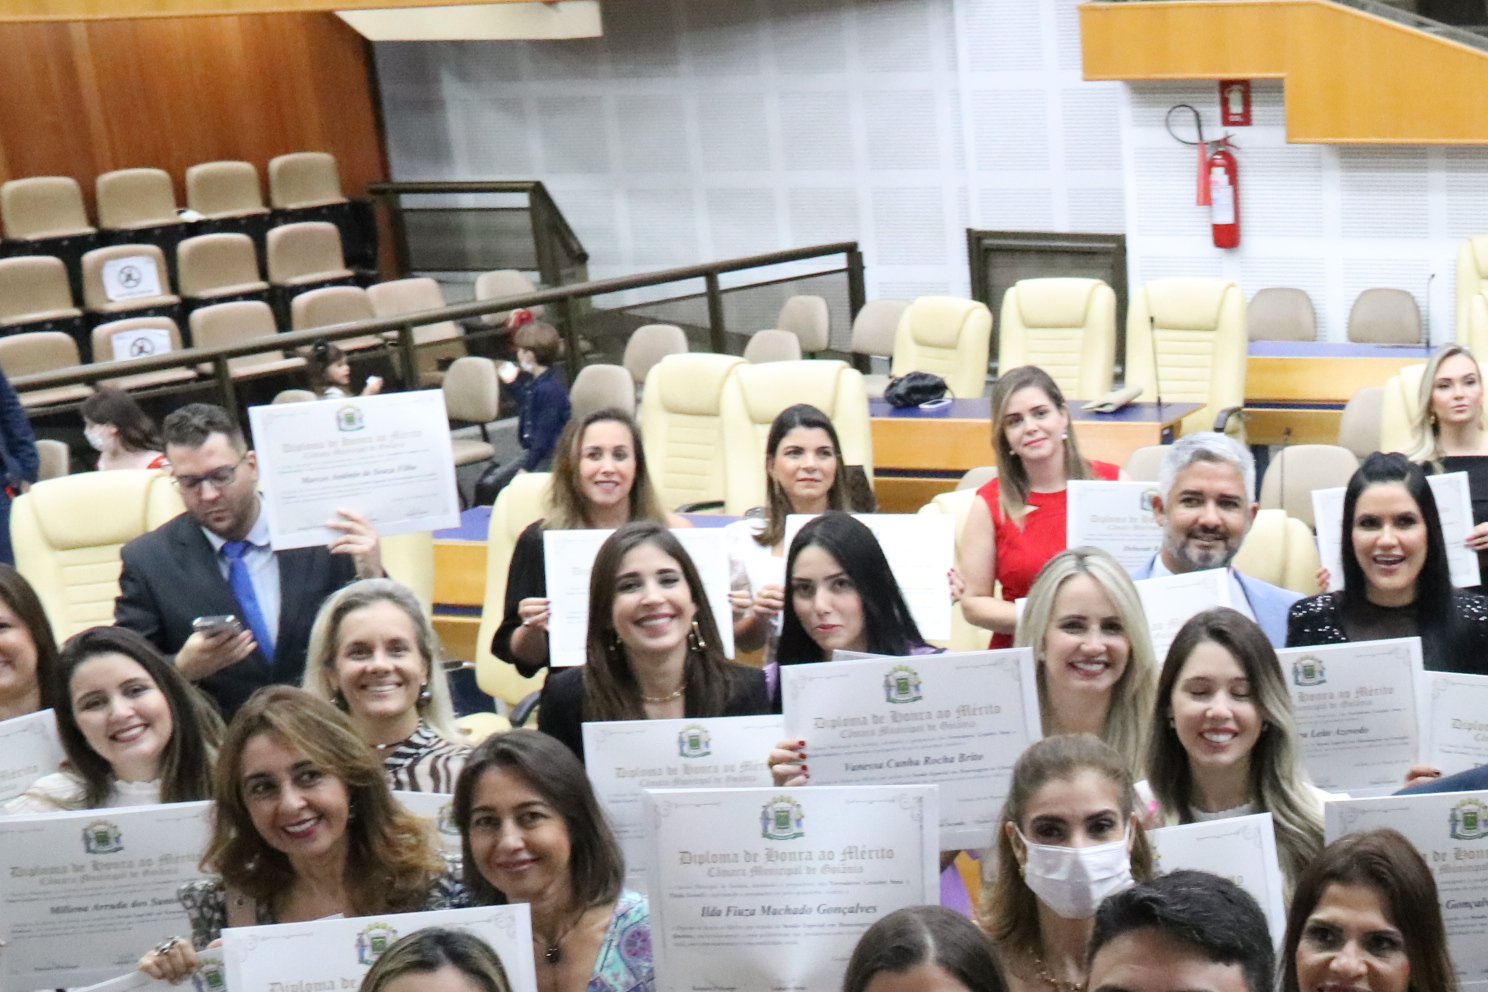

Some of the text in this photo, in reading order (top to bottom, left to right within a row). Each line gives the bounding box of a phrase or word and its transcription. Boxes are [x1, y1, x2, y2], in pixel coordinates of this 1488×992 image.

[679, 845, 894, 865] Diploma de Honra ao Mérito
[701, 905, 722, 918] Ilda
[759, 903, 812, 916] Machado
[816, 902, 877, 916] Gonçalves
